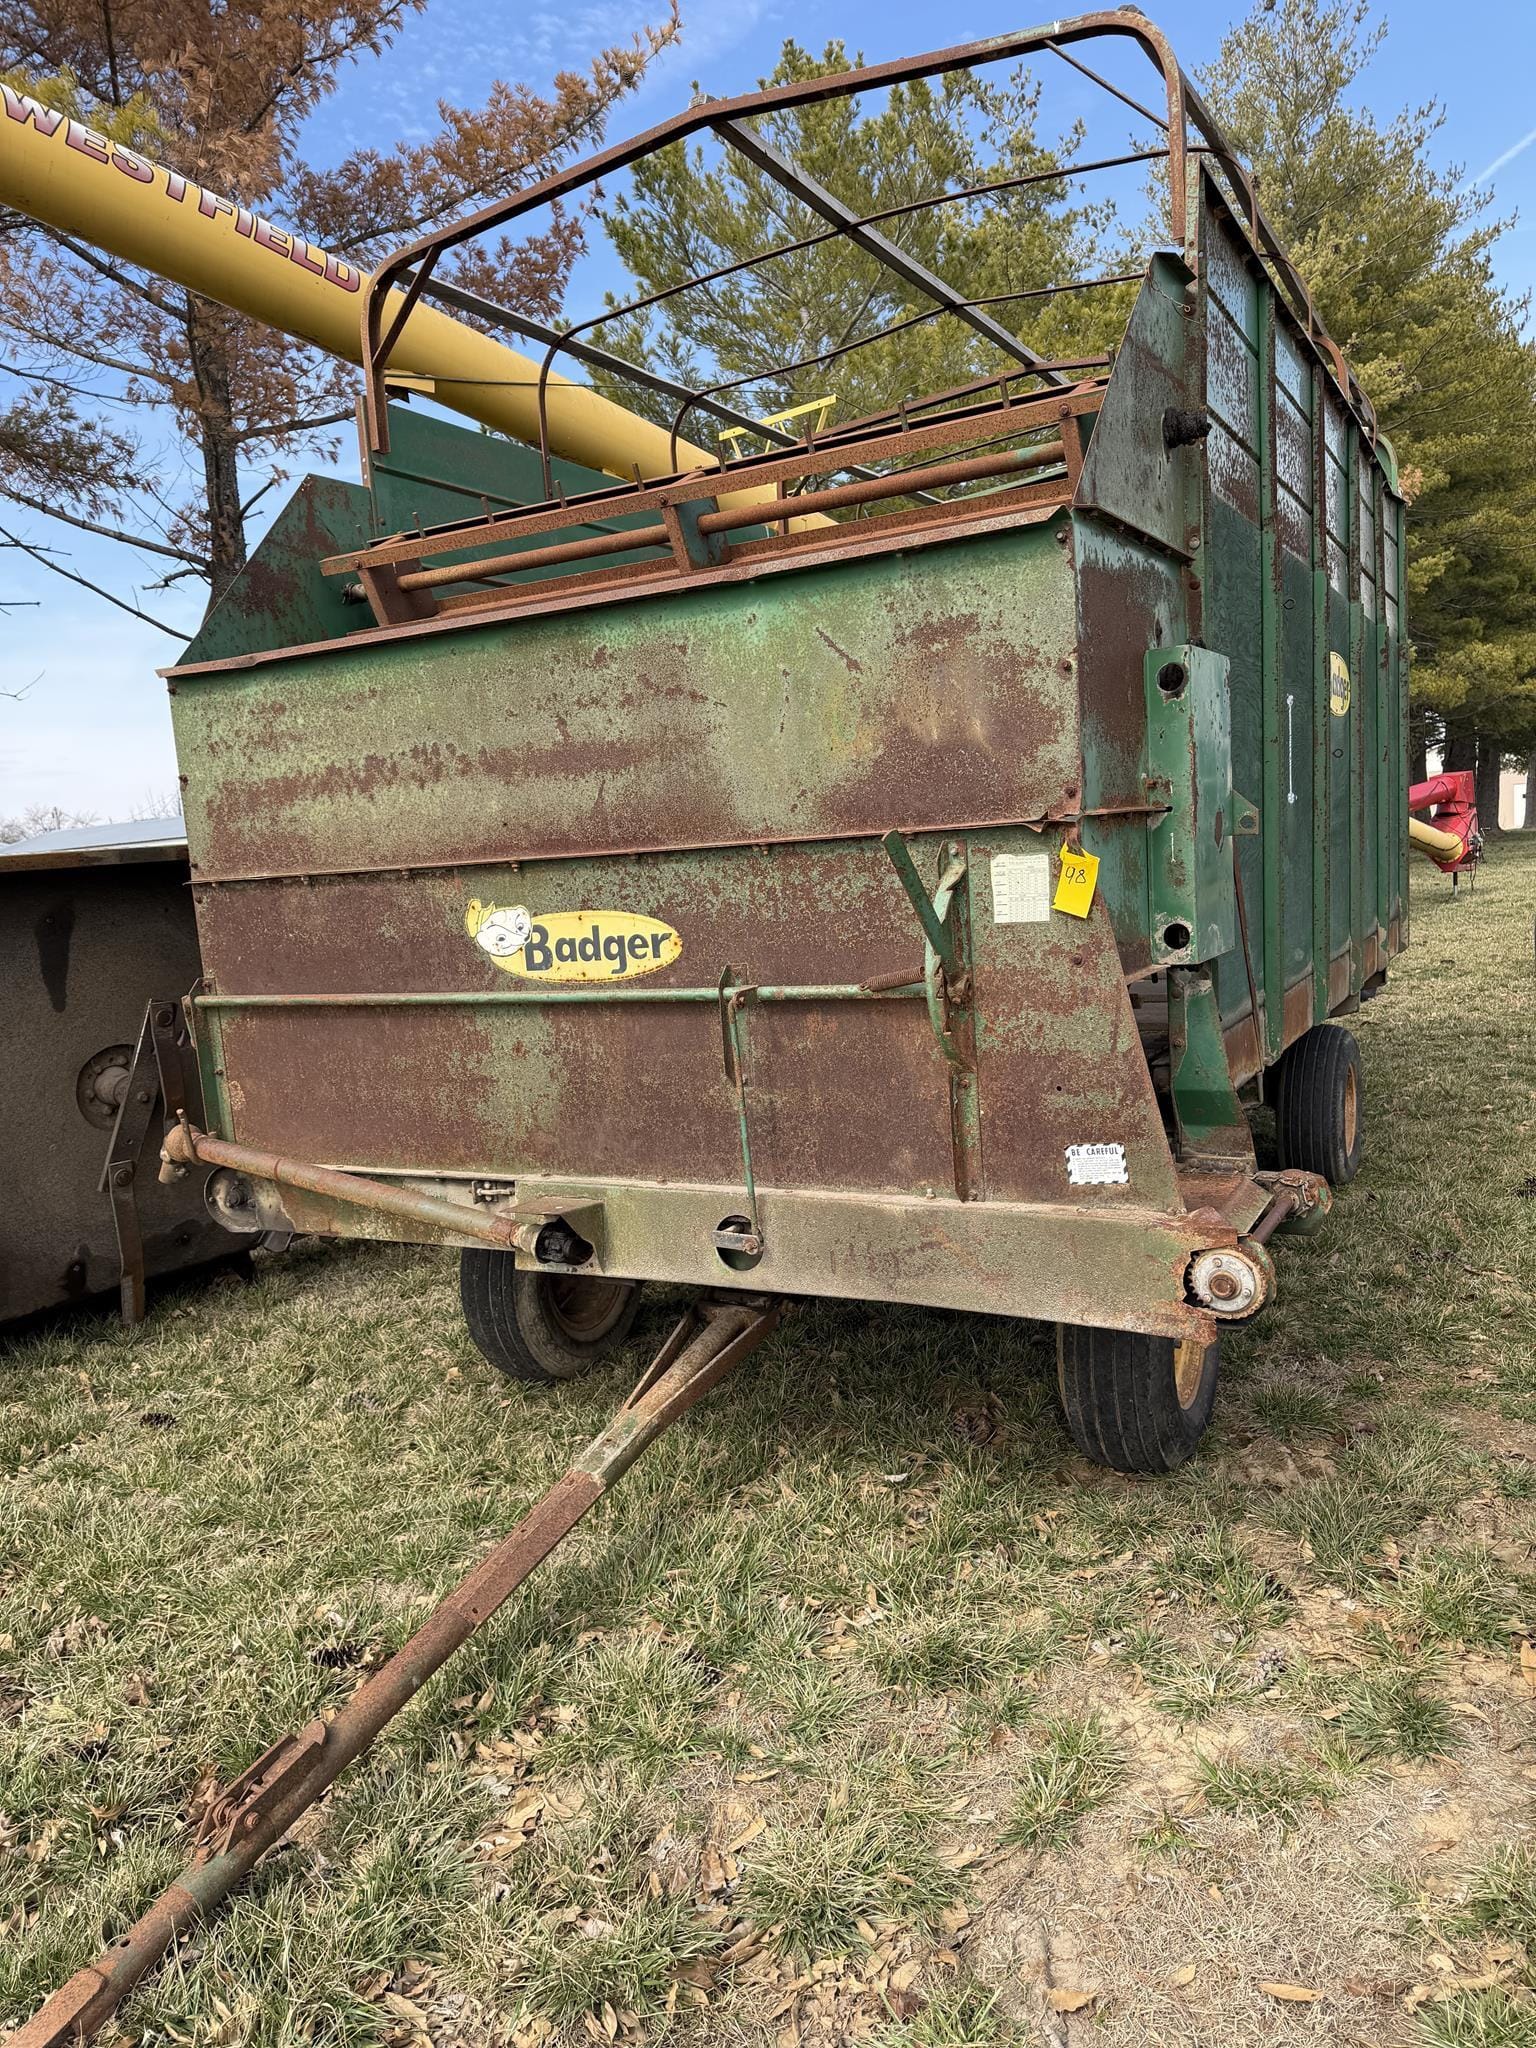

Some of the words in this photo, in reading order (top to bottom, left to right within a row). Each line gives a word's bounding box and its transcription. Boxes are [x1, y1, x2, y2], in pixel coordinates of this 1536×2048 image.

[0, 83, 361, 293] WESTFIELD
[1065, 866, 1086, 884] 98
[524, 925, 672, 974] Badger
[1071, 1148, 1080, 1156] BE
[1086, 1147, 1118, 1155] CAREFUL
